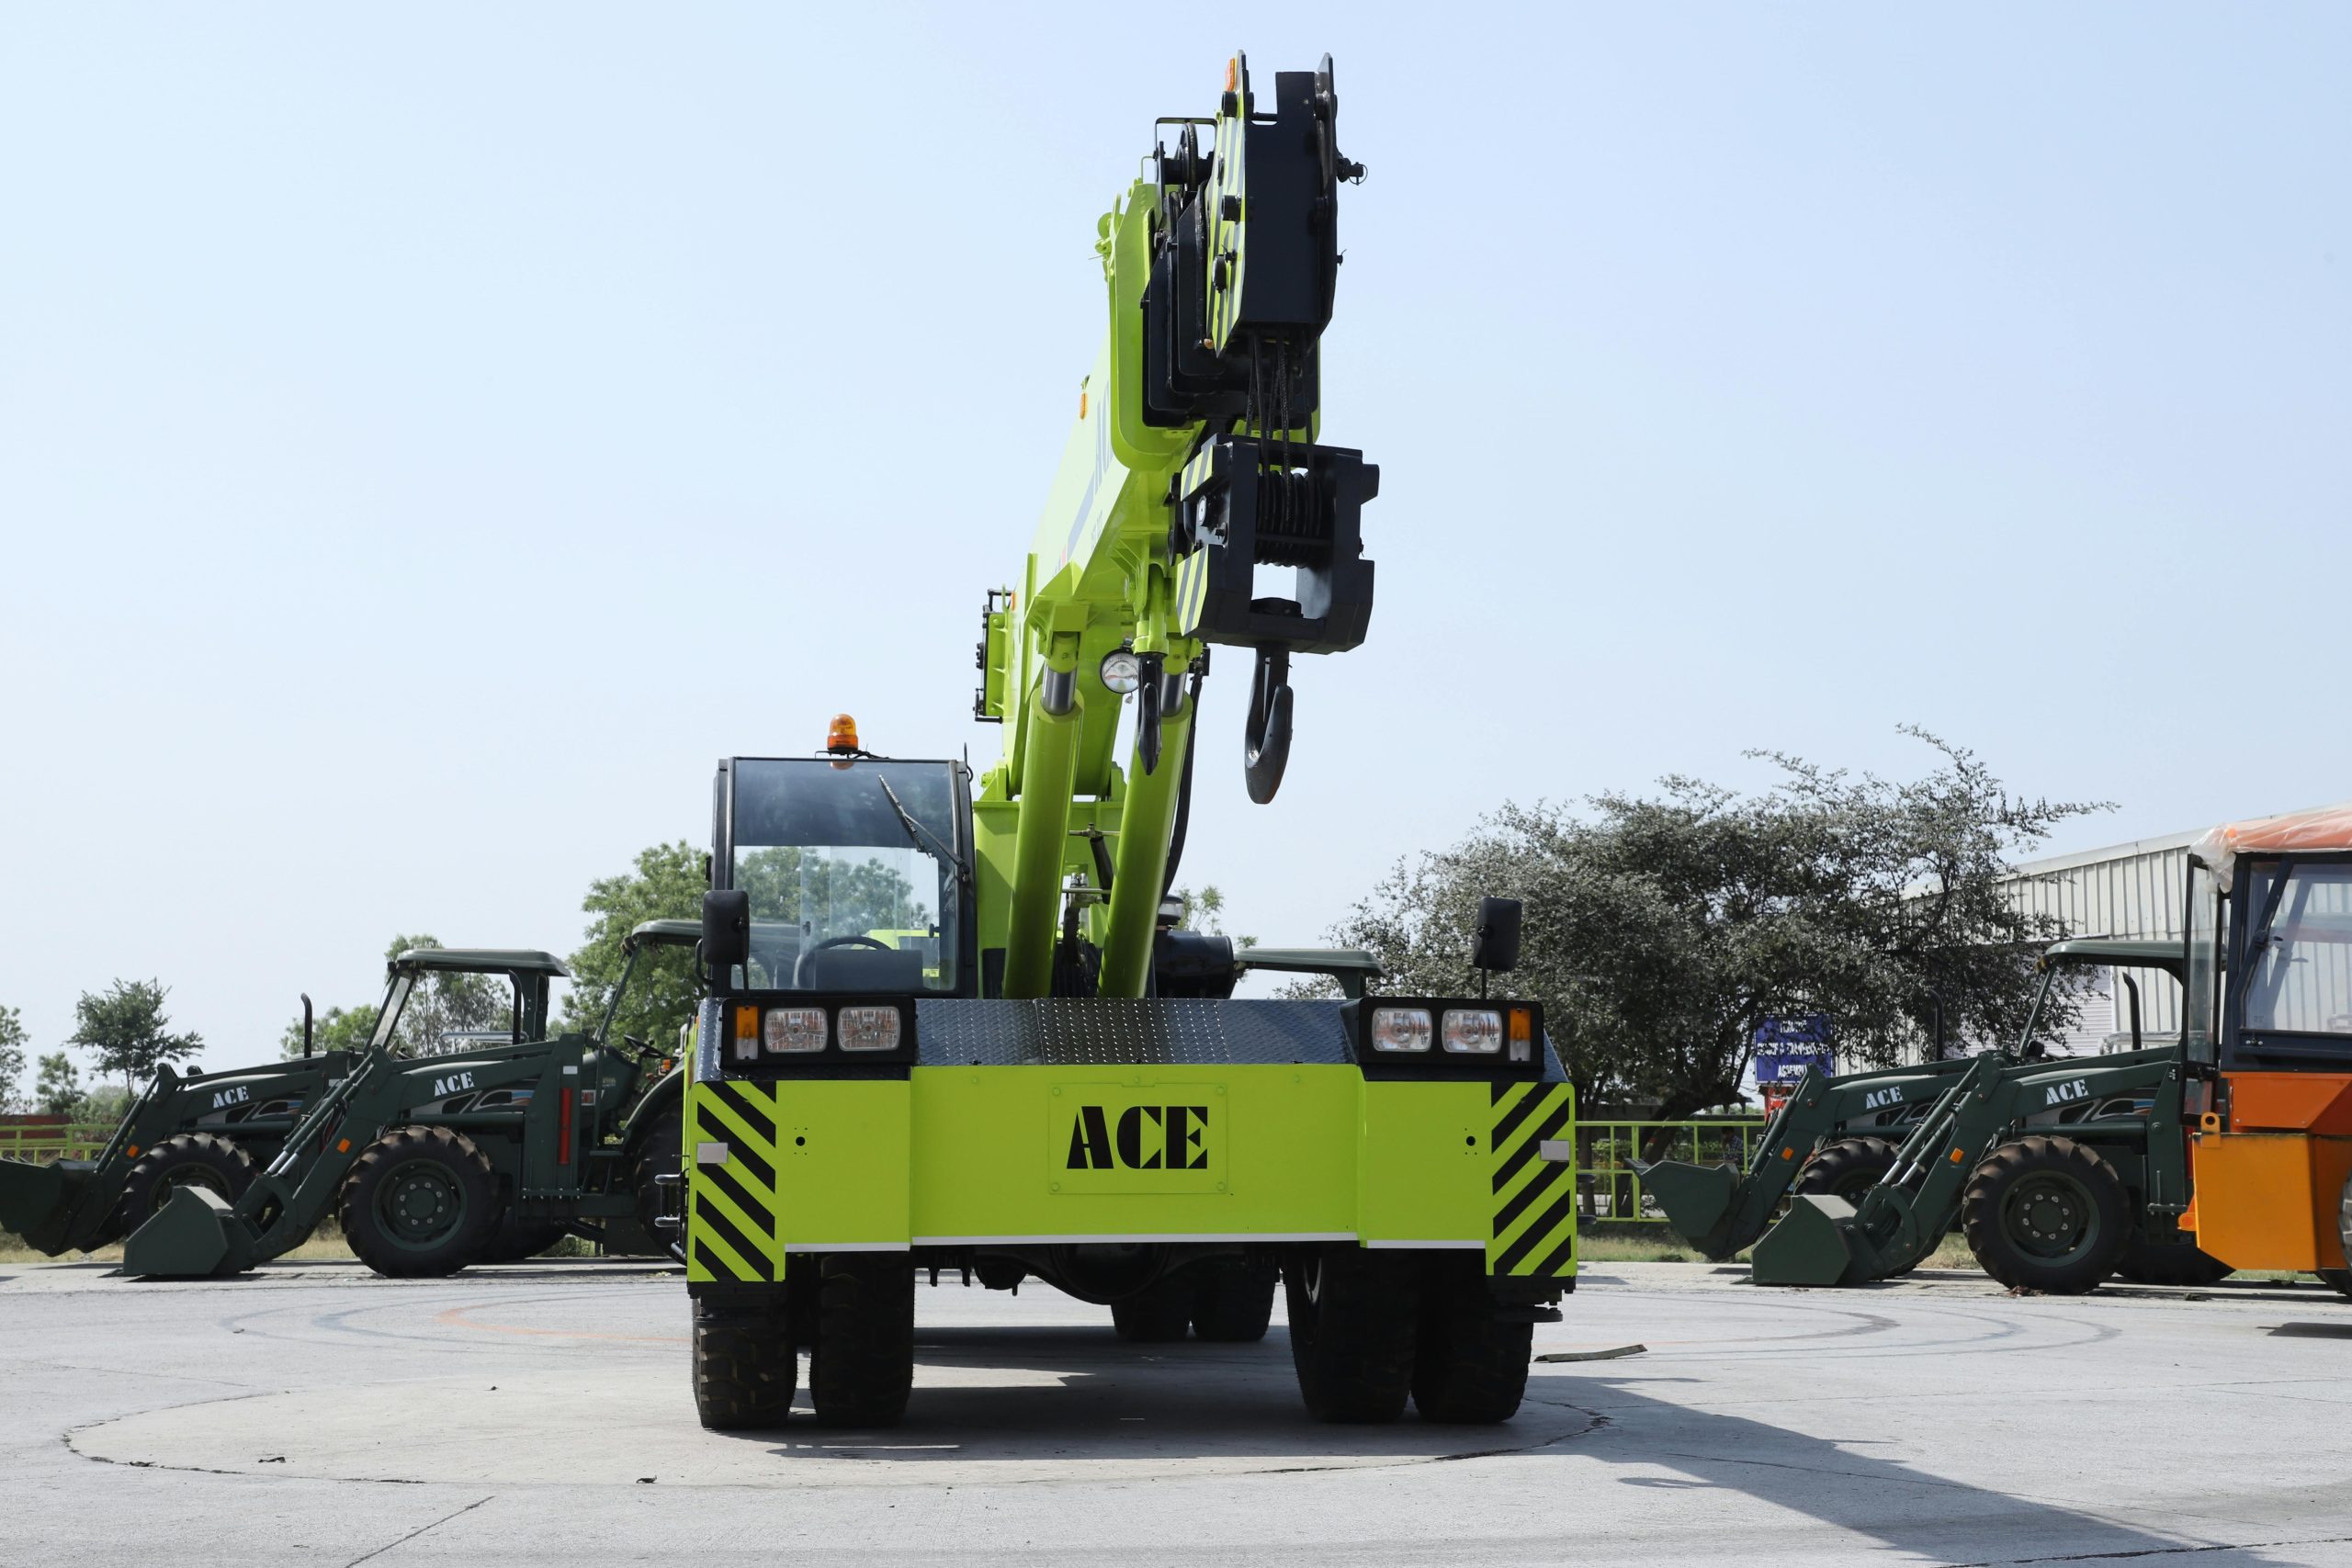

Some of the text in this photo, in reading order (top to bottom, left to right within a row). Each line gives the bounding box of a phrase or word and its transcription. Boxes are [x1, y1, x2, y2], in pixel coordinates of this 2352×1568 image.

[434, 1072, 475, 1097] ACE
[2046, 1078, 2089, 1105] ACE
[213, 1086, 249, 1109] ACE
[1866, 1085, 1904, 1110] ACE
[1067, 1106, 1208, 1169] ACE
